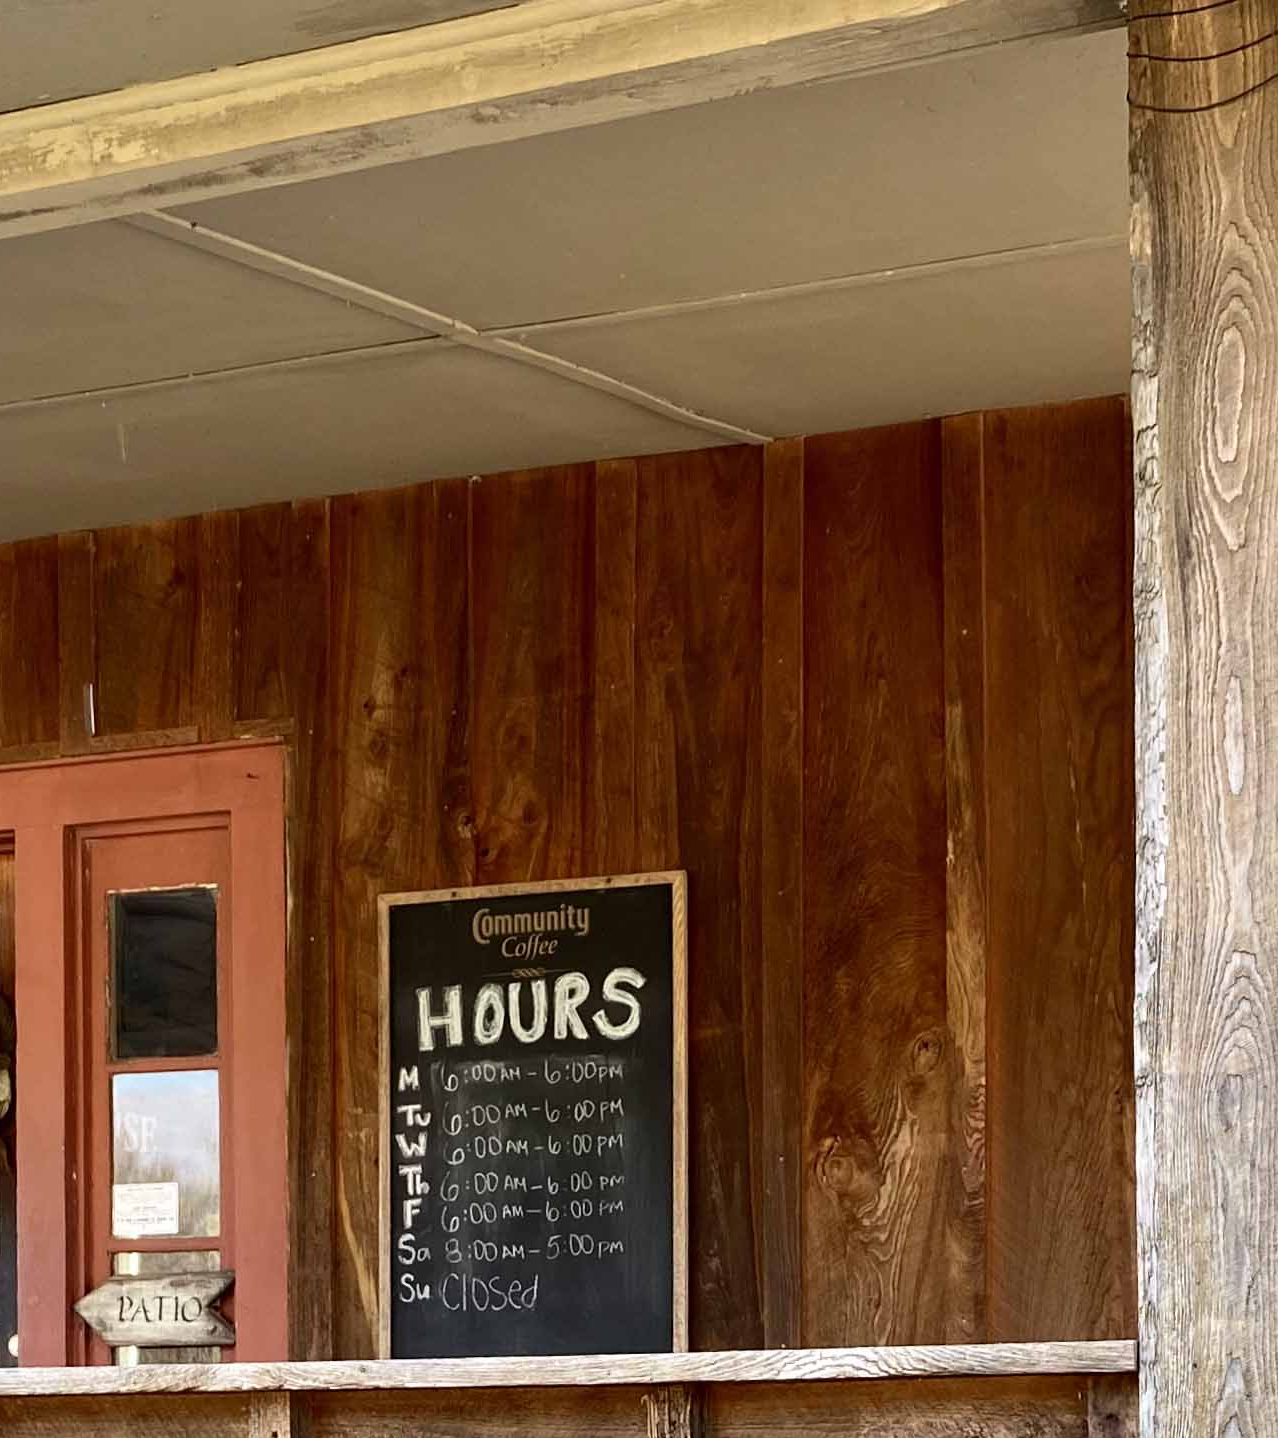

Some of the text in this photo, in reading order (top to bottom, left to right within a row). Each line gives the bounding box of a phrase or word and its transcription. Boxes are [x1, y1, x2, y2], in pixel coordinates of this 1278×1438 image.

[472, 904, 590, 944] Community
[501, 933, 558, 960] Coffee
[415, 967, 646, 1052] HOURS
[398, 1065, 420, 1092] M
[395, 1131, 428, 1158] W
[398, 1164, 431, 1196] Th
[402, 1199, 423, 1230] F
[397, 1233, 431, 1265] Sa
[399, 1272, 431, 1303] Su
[118, 1295, 203, 1323] PATIO
